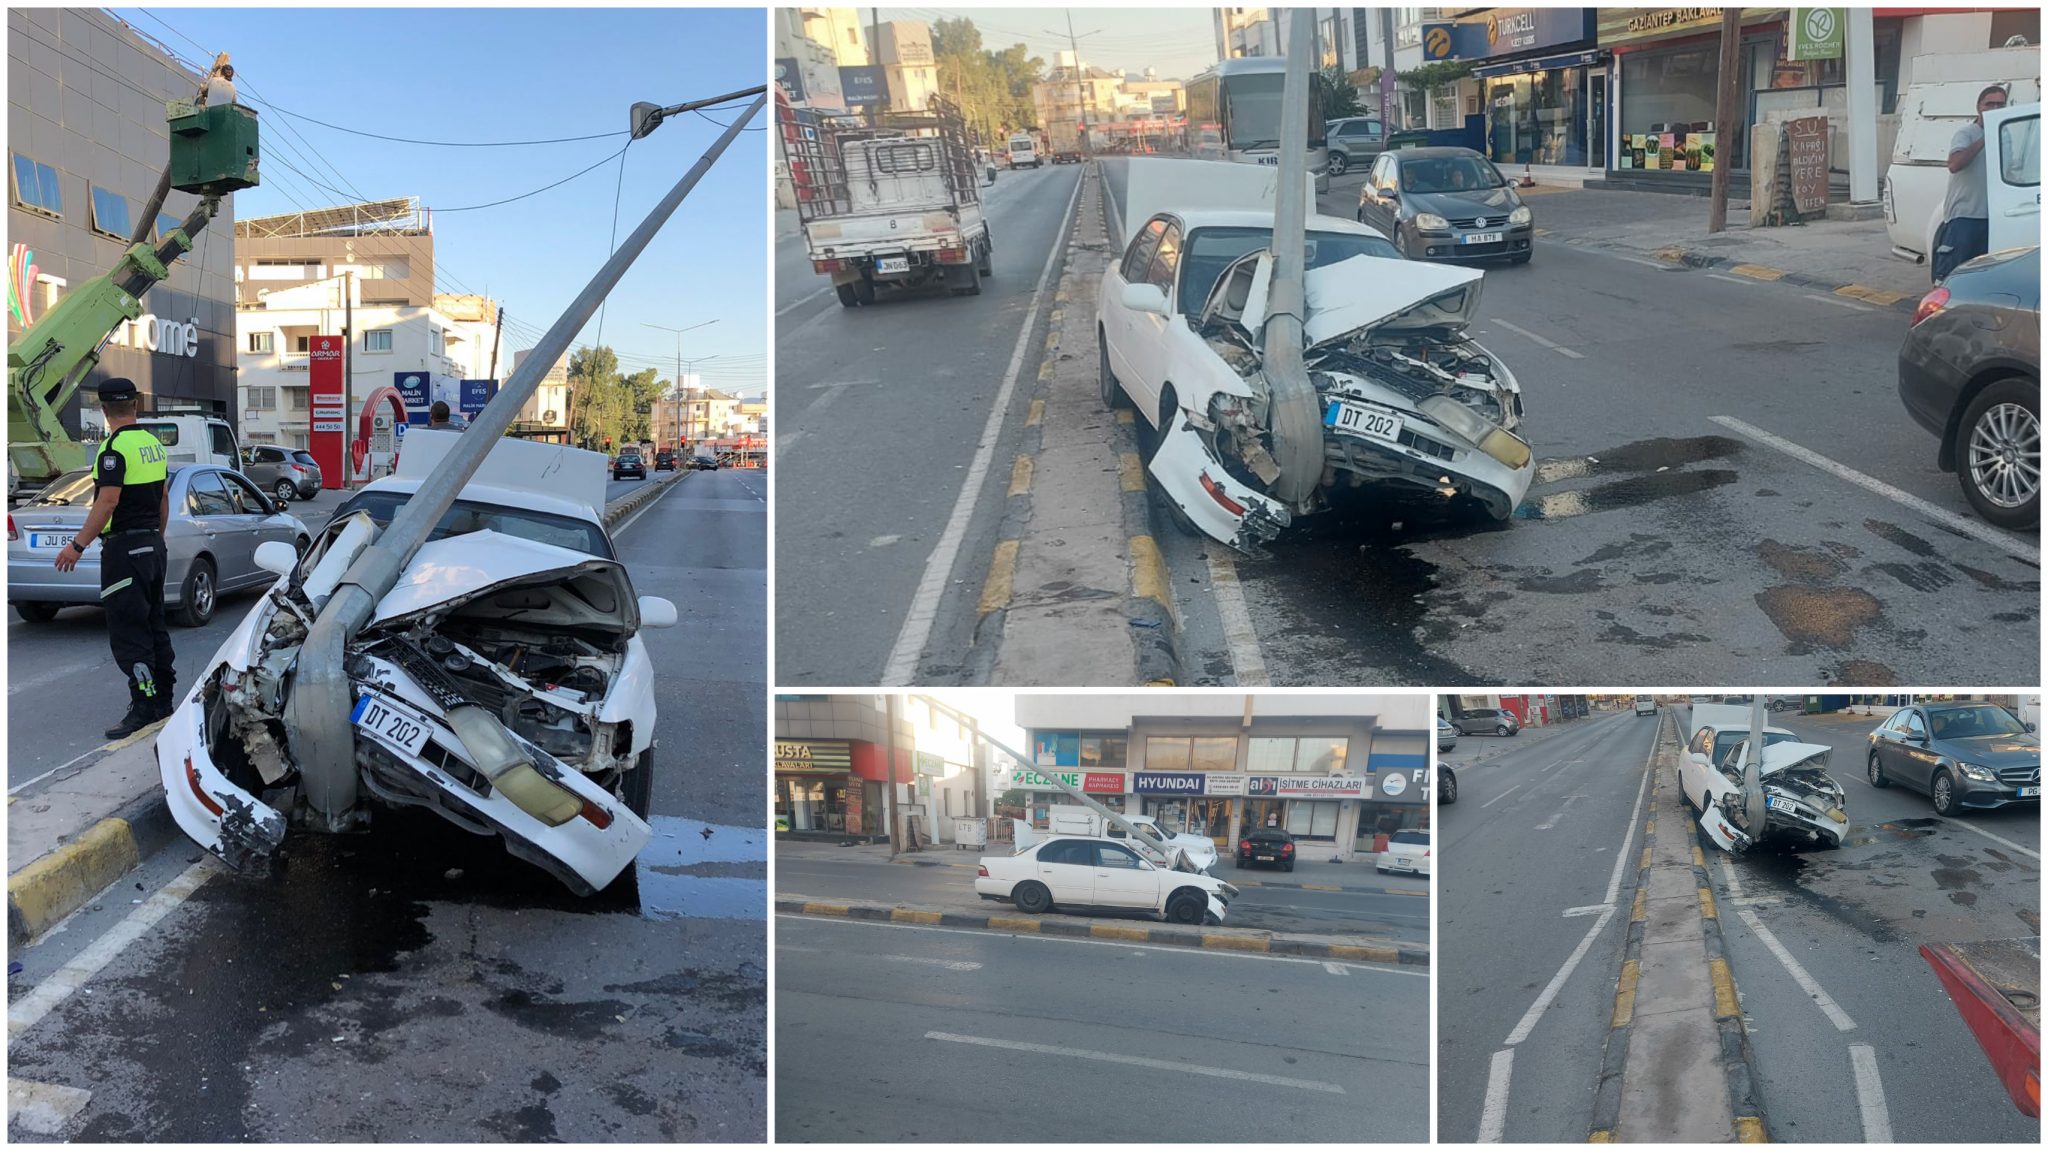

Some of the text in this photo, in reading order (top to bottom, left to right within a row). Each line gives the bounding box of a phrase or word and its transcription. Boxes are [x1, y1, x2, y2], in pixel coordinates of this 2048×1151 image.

[1498, 13, 1535, 36] TURKCELL
[1796, 120, 1816, 133] SU
[1341, 408, 1394, 436] DT 202
[45, 535, 75, 546] JU 85
[364, 704, 421, 748] DT 202
[776, 745, 811, 758] USTA
[1026, 772, 1079, 786] ECZNE
[1138, 777, 1200, 789] HYUNDAI
[1280, 778, 1362, 790] İŞİTME CİHAZLARI
[1772, 799, 1794, 811] DT 202
